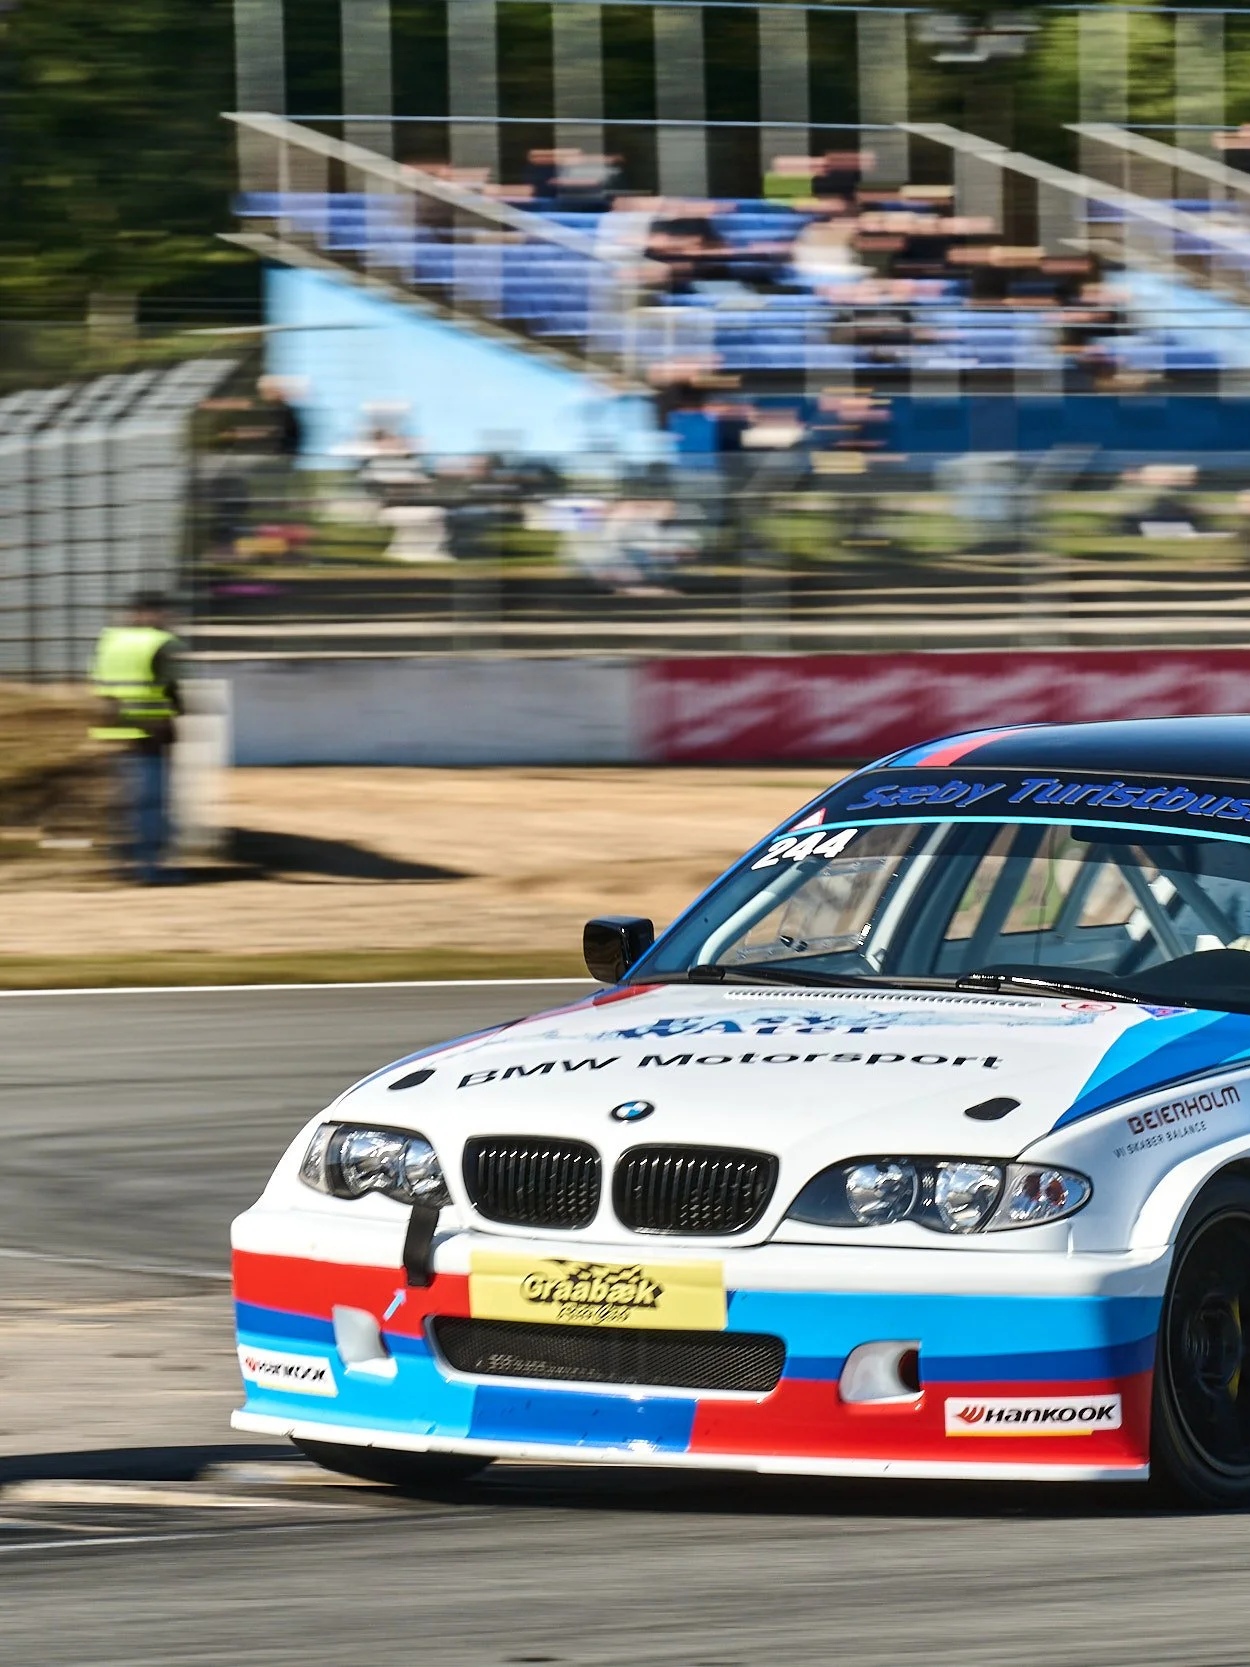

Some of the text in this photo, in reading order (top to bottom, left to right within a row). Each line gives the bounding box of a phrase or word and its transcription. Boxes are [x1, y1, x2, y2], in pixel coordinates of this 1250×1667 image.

[847, 779, 1006, 811] Sæby
[751, 828, 858, 870] 244
[456, 1053, 1004, 1089] BMW Motorsport
[1127, 1086, 1241, 1135] BEIERHOLM
[1166, 1120, 1208, 1142] BALANCE
